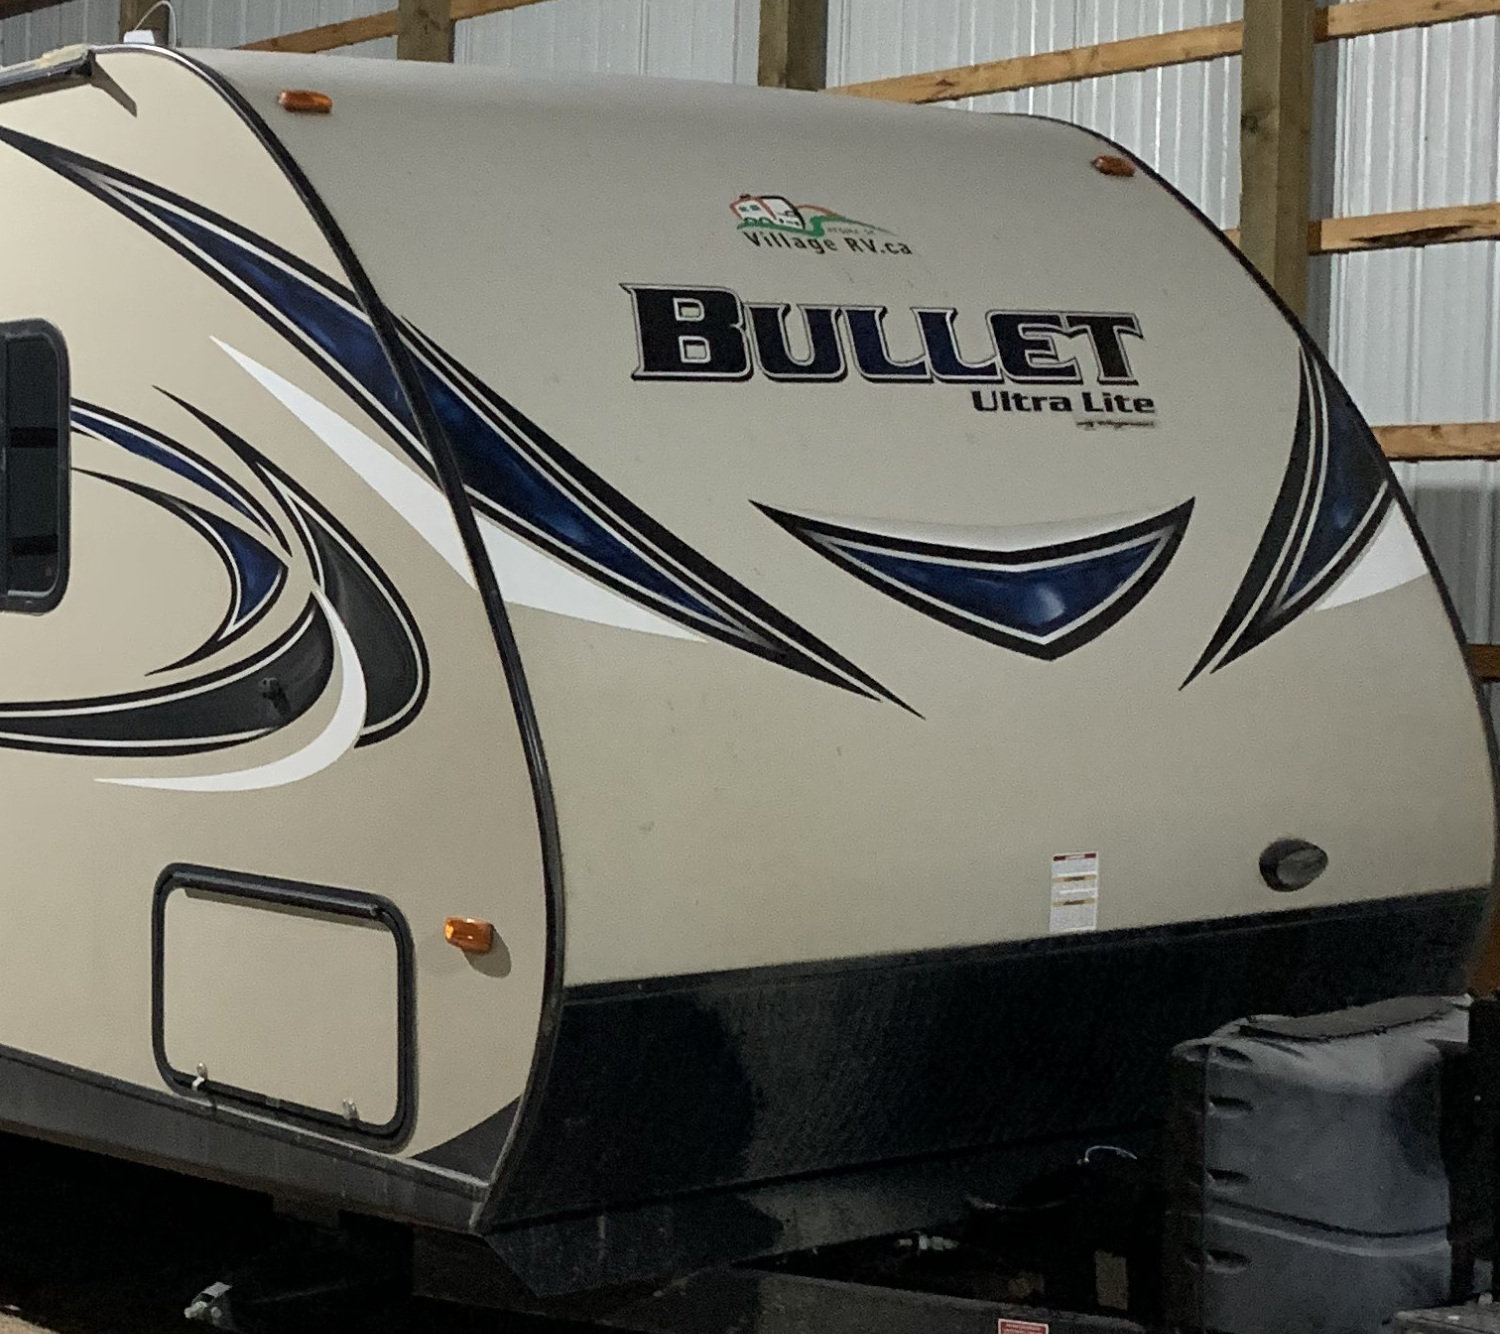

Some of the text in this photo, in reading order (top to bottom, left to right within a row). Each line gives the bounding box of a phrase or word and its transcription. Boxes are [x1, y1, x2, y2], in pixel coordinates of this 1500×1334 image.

[743, 231, 838, 255] Village
[844, 236, 913, 255] RV.ca
[619, 282, 1144, 386] BULLET
[971, 390, 1156, 414] Ultra Lite
